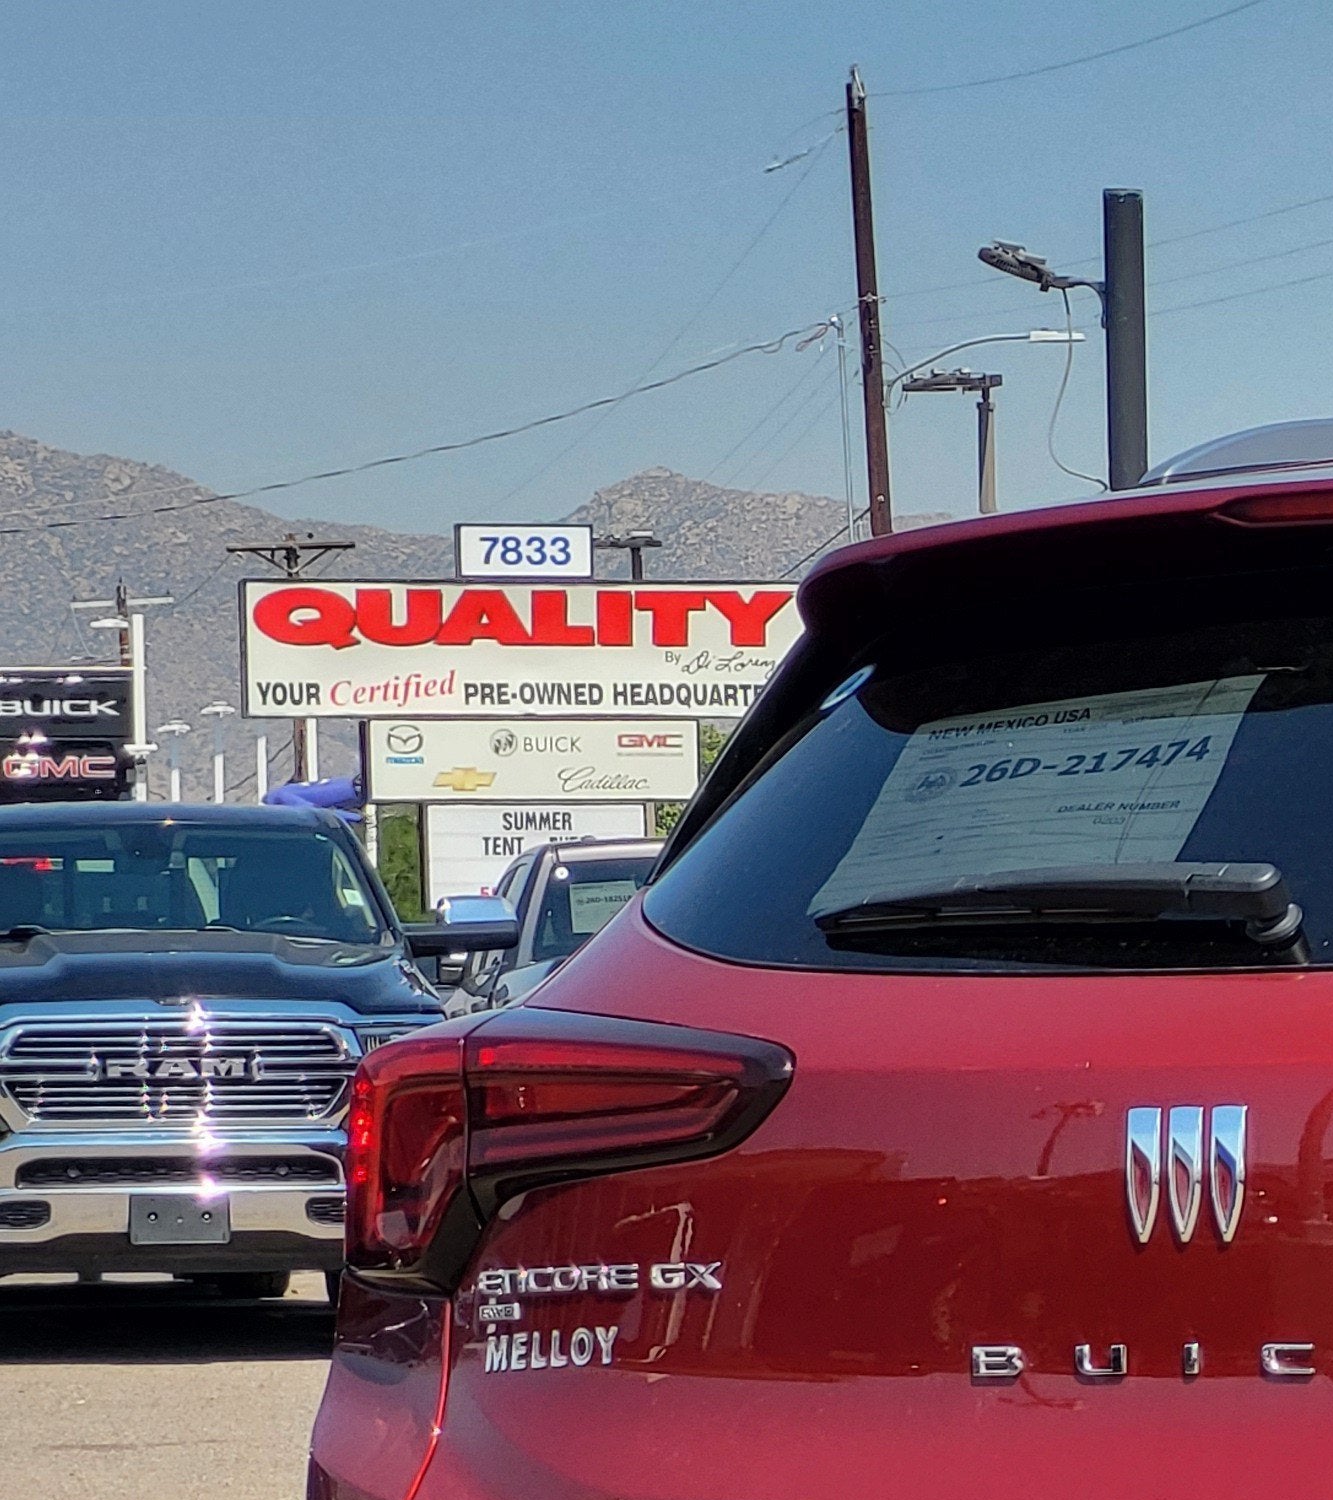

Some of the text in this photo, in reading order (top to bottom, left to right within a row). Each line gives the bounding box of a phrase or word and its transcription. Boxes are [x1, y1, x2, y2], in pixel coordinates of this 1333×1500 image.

[479, 536, 571, 566] 7833
[253, 587, 794, 650] QUALITY
[665, 651, 682, 665] By
[714, 651, 776, 680] Lorenz
[257, 669, 767, 708] YOUR Certified PRE-OWNED HEADQUART
[0, 700, 119, 716] BUICK
[928, 724, 974, 742] NEW
[975, 714, 1049, 738] MEXICO
[1053, 707, 1091, 724] USA
[523, 736, 582, 753] BUICK
[618, 734, 683, 748] GMC
[3, 755, 116, 779] GMC
[958, 734, 1213, 788] 26D-217474
[557, 766, 649, 793] Cadillac
[1117, 800, 1181, 811] NUMBER
[502, 812, 573, 831] SUMMER
[482, 836, 525, 856] TENT
[106, 1058, 247, 1077] RAM
[479, 1261, 722, 1295] ENCORE GX
[484, 1325, 619, 1374] MELLOY
